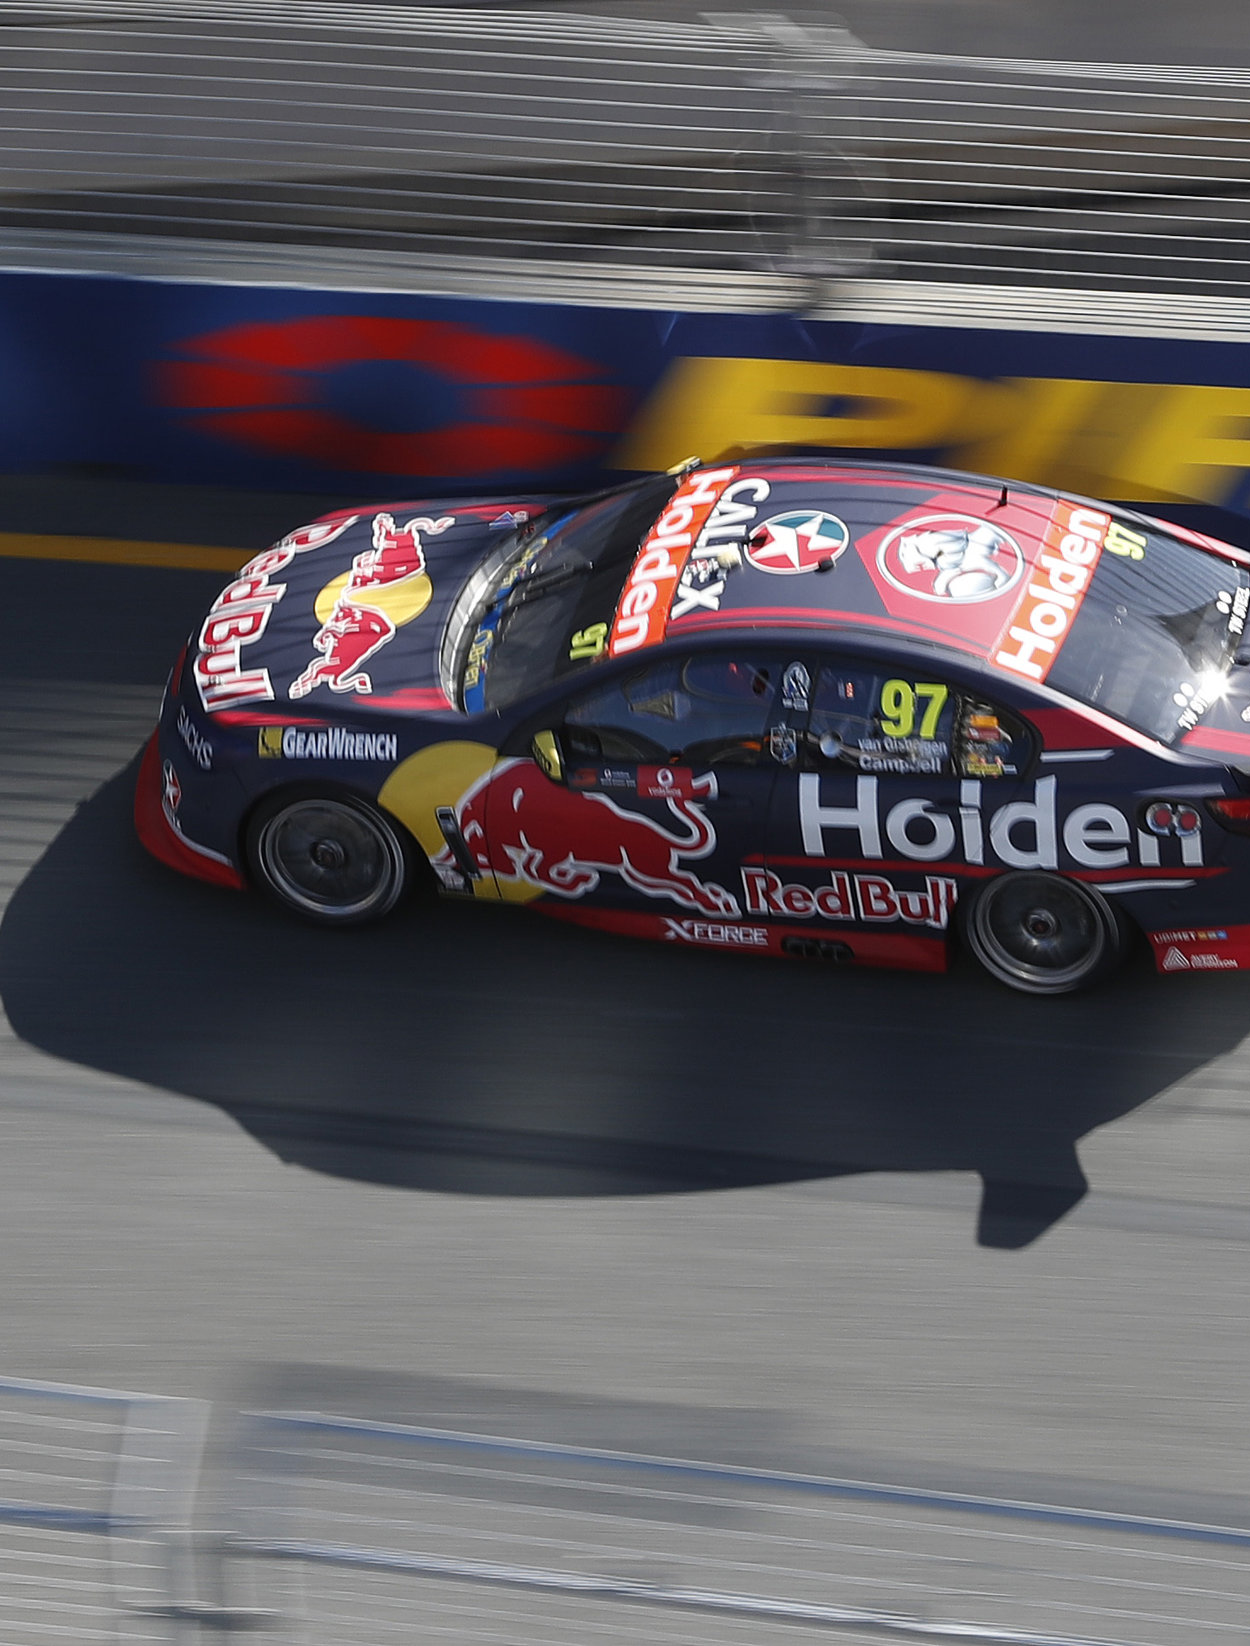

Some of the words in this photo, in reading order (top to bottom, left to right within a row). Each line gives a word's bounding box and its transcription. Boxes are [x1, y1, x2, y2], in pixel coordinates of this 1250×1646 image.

[613, 468, 735, 655] Holden
[1103, 521, 1147, 561] 97
[996, 508, 1107, 680] Holden
[177, 704, 214, 771] SACHS
[880, 678, 949, 740] 97
[799, 771, 1205, 870] Holden
[660, 917, 769, 947] XFORCE
